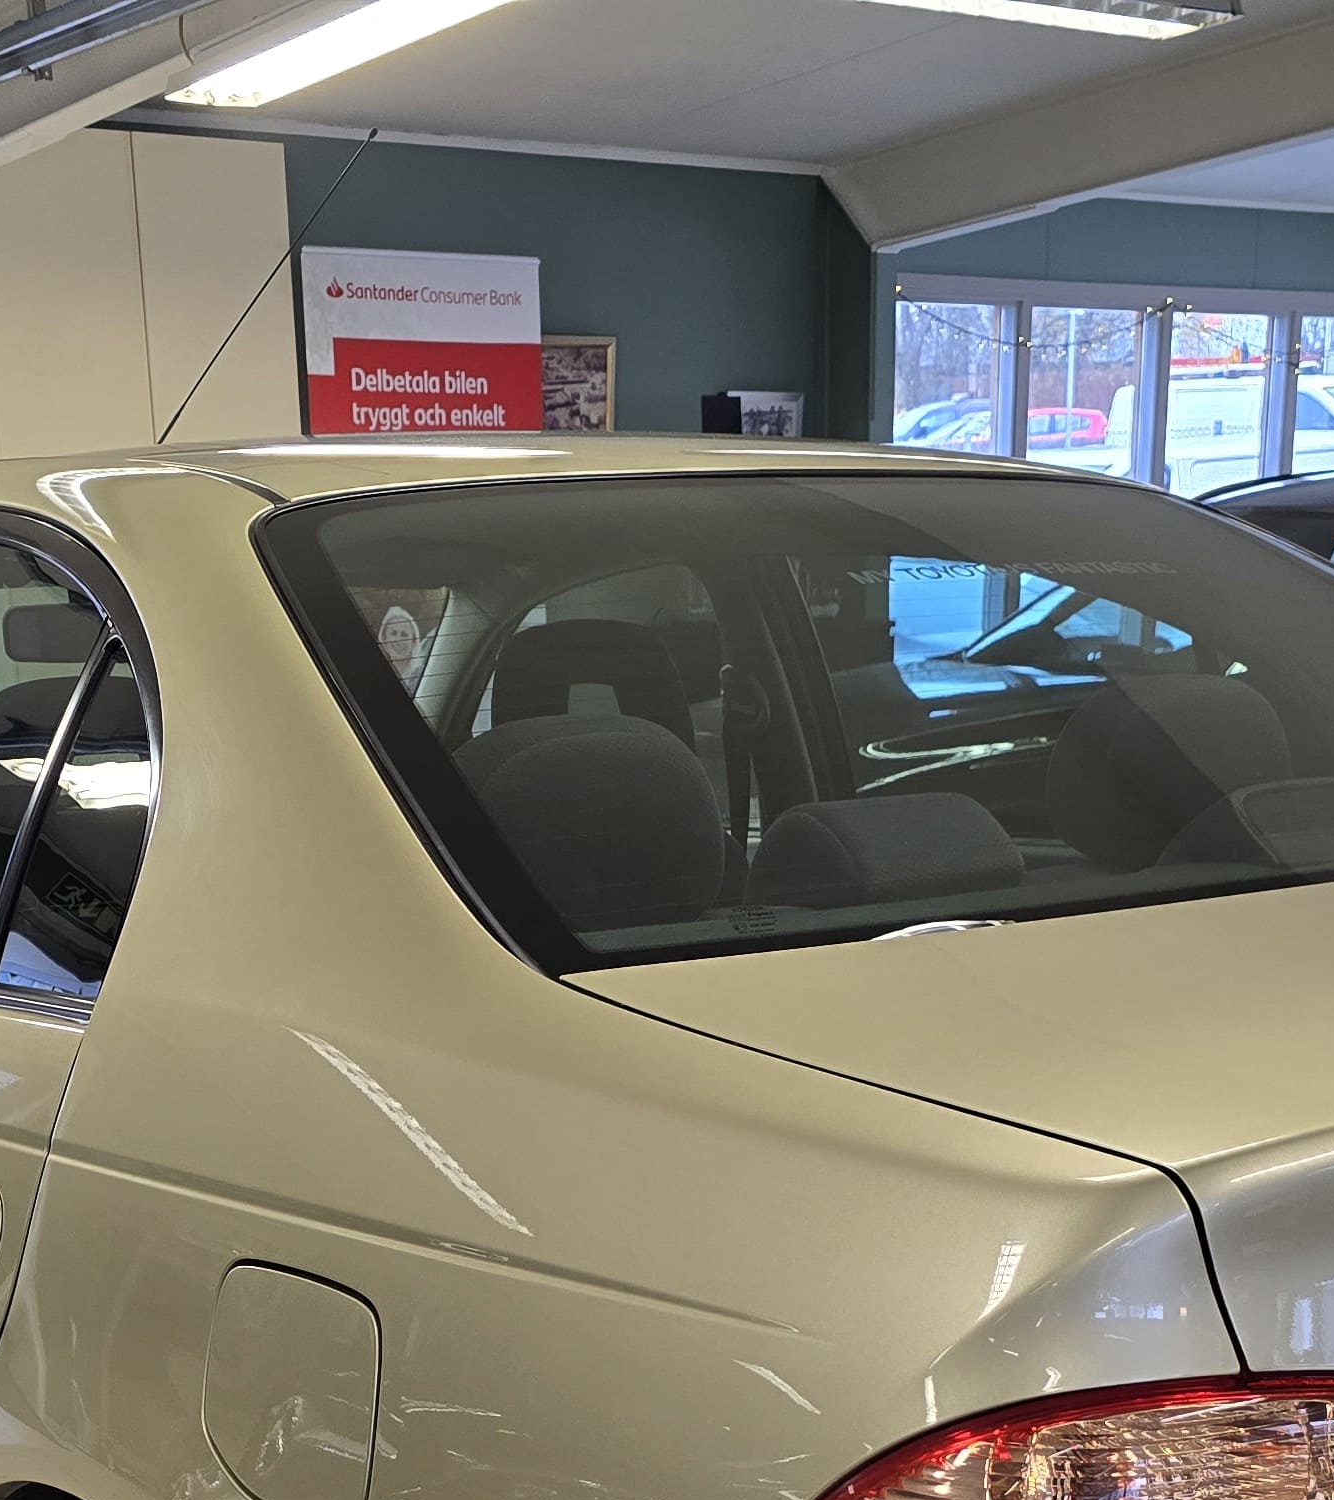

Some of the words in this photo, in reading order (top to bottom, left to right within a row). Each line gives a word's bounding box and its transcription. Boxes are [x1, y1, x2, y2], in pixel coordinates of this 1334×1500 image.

[346, 282, 419, 302] Santander
[420, 286, 487, 306] Consumer
[489, 289, 522, 307] Bank
[351, 367, 440, 392] Delbetala
[444, 369, 488, 395] bilen
[352, 402, 410, 431] tryggt
[414, 402, 446, 427] och
[451, 403, 505, 427] enkelt
[846, 568, 896, 585] MY
